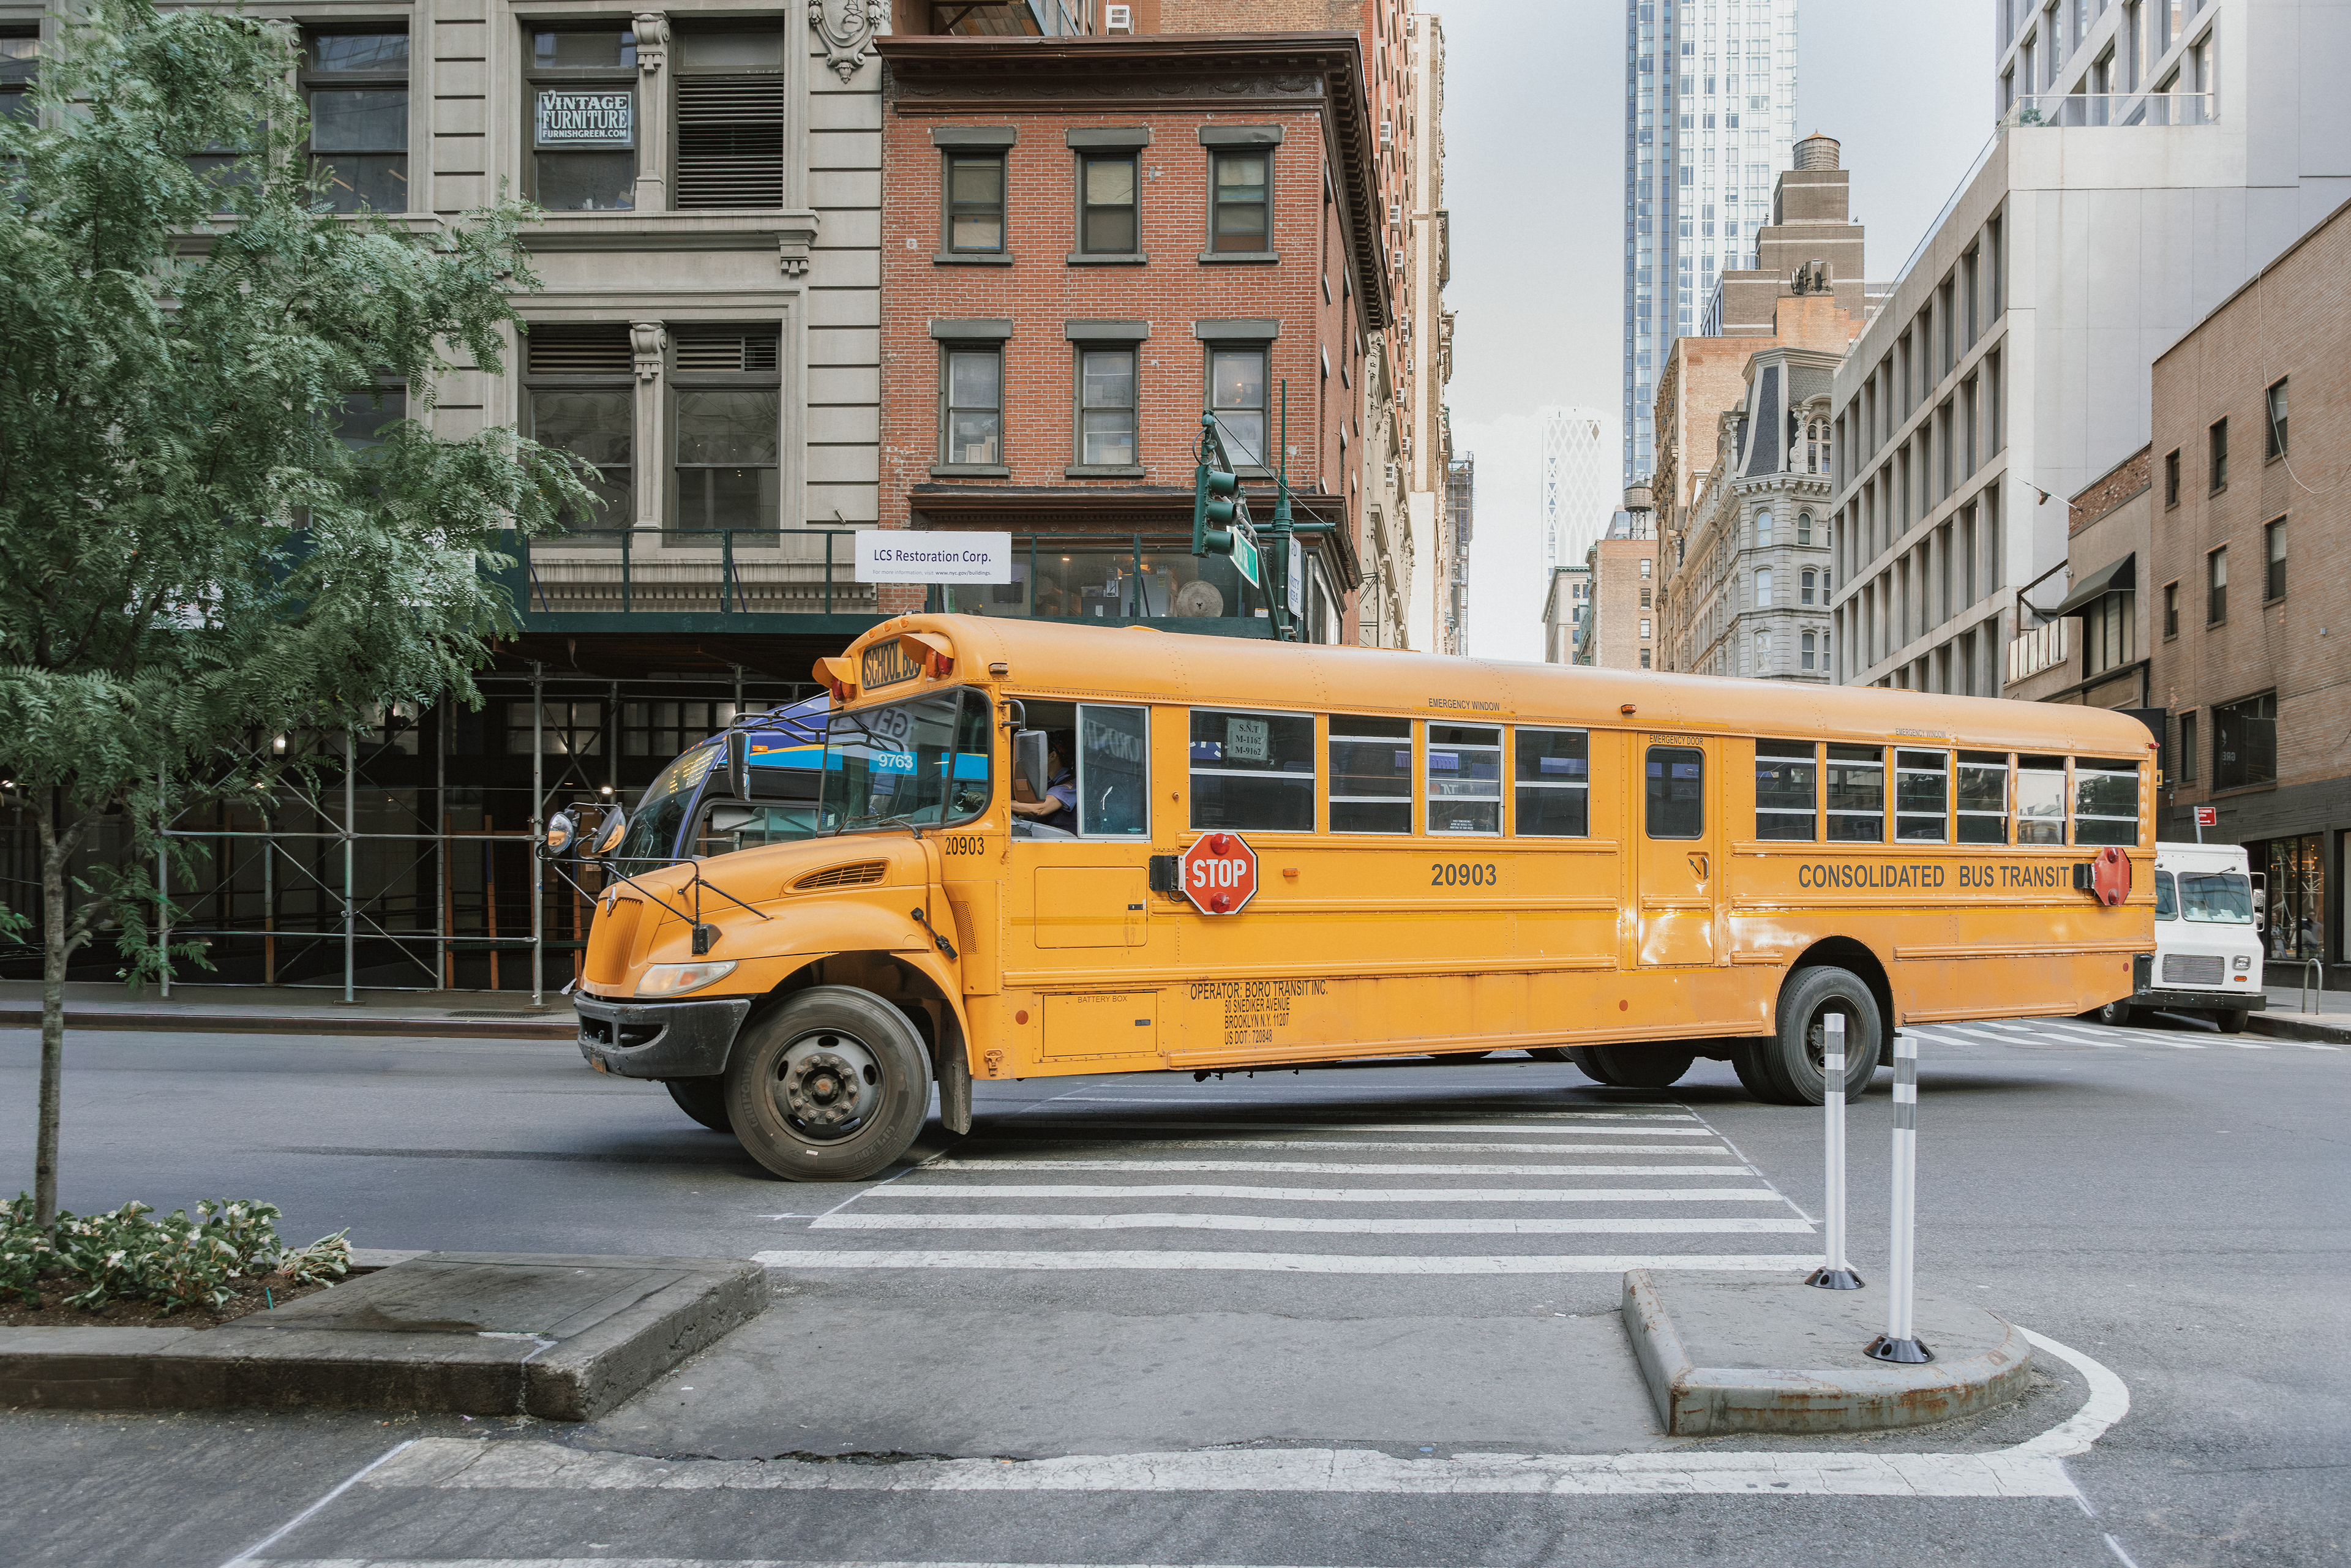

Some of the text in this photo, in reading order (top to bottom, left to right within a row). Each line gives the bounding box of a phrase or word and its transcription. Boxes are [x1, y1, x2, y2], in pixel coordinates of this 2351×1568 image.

[542, 90, 628, 110] VINTAGE
[542, 110, 627, 129] FURNITURE
[874, 549, 992, 565] LCS Restoration Corp.
[866, 642, 901, 686] SCHOOL
[1428, 698, 1500, 711] EMERGENCY WINDOW
[1235, 735, 1261, 745] M-1162
[1649, 735, 1704, 746] EMERGENCY DOOR
[1895, 728, 1925, 737] EMERGENCY
[1235, 746, 1261, 756] M-9162
[878, 754, 913, 768] 9763
[945, 836, 984, 855] 20903
[1193, 859, 1247, 887] STOP
[1431, 864, 1497, 886] 20903
[1799, 864, 2070, 888] CONSOLIDATED BUS TRANSIT
[1190, 980, 1329, 1000] OPERATOR: BORO TRANSIT INC.
[1225, 997, 1290, 1013] 50 SNEDIKER AVENUE
[1224, 1013, 1289, 1029] BROOKLYN N.Y. 11207
[1224, 1031, 1233, 1045] US
[1252, 1029, 1272, 1043] 720848
